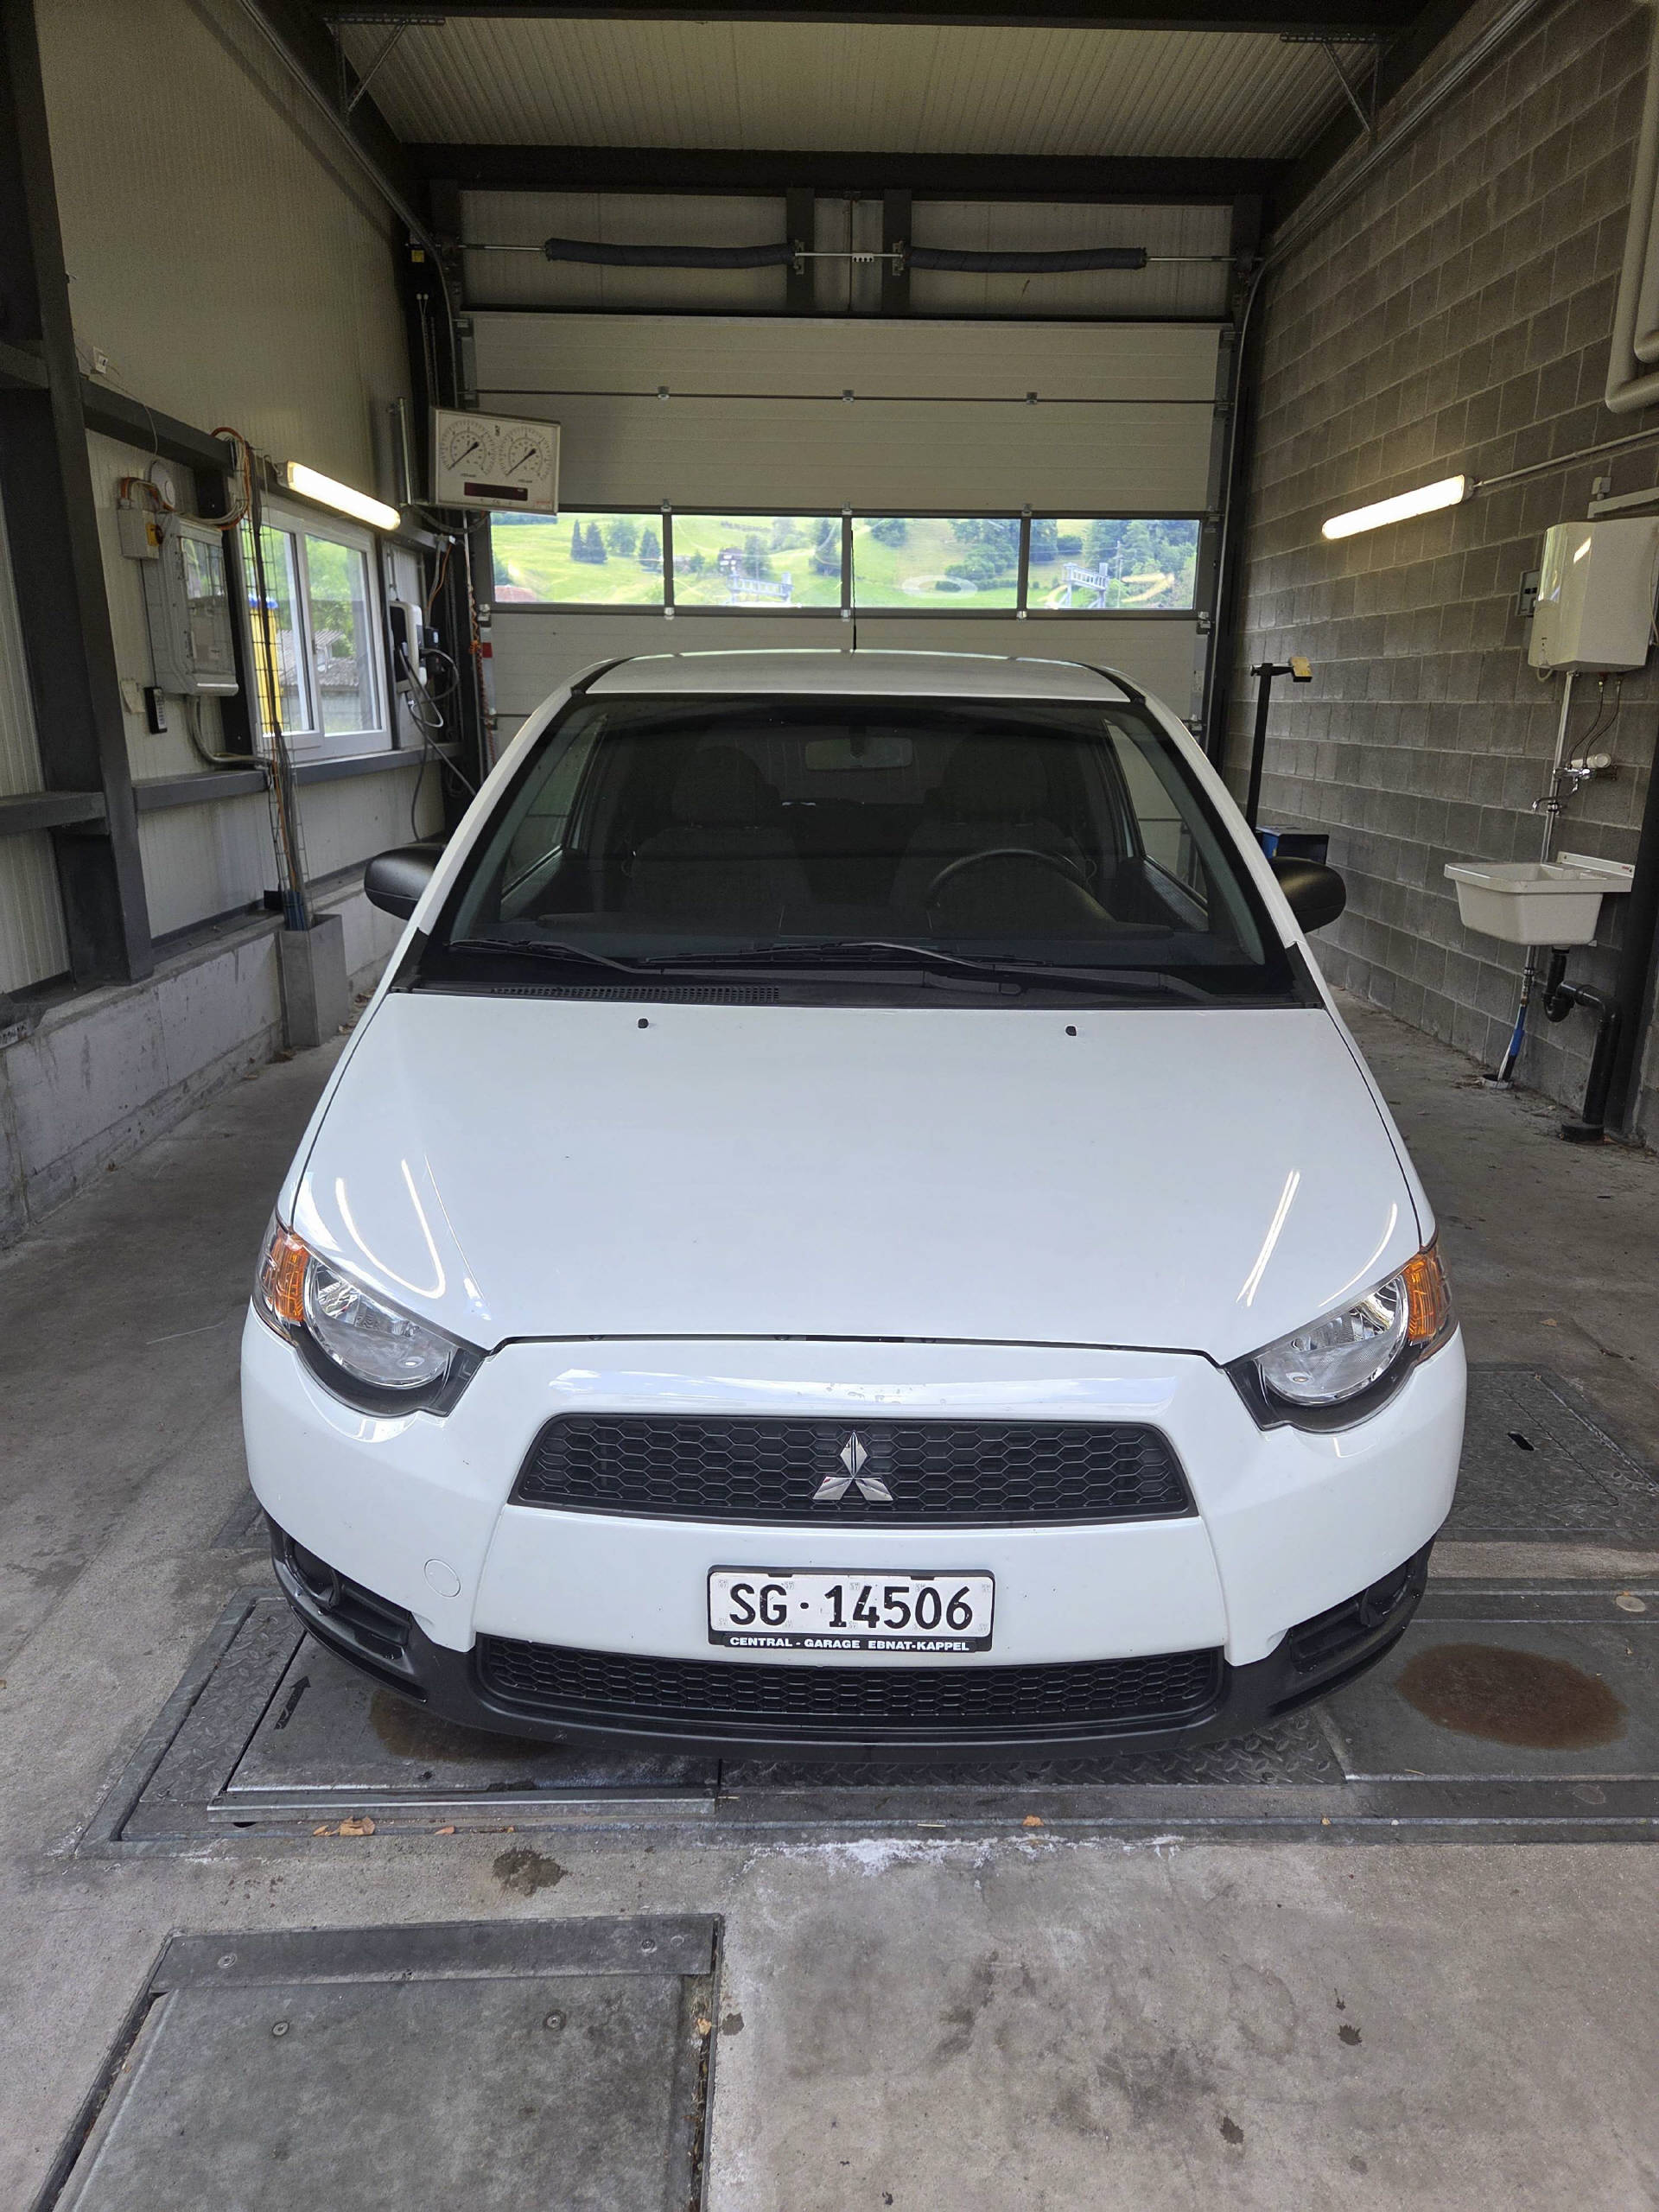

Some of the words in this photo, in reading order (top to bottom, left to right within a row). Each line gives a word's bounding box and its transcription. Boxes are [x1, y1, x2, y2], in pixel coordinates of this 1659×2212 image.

[824, 1585, 973, 1630] 14506
[729, 1637, 792, 1647] CENTRAL
[804, 1638, 861, 1649] GARAGE
[868, 1640, 969, 1651] EBNAT-KAPPEL
